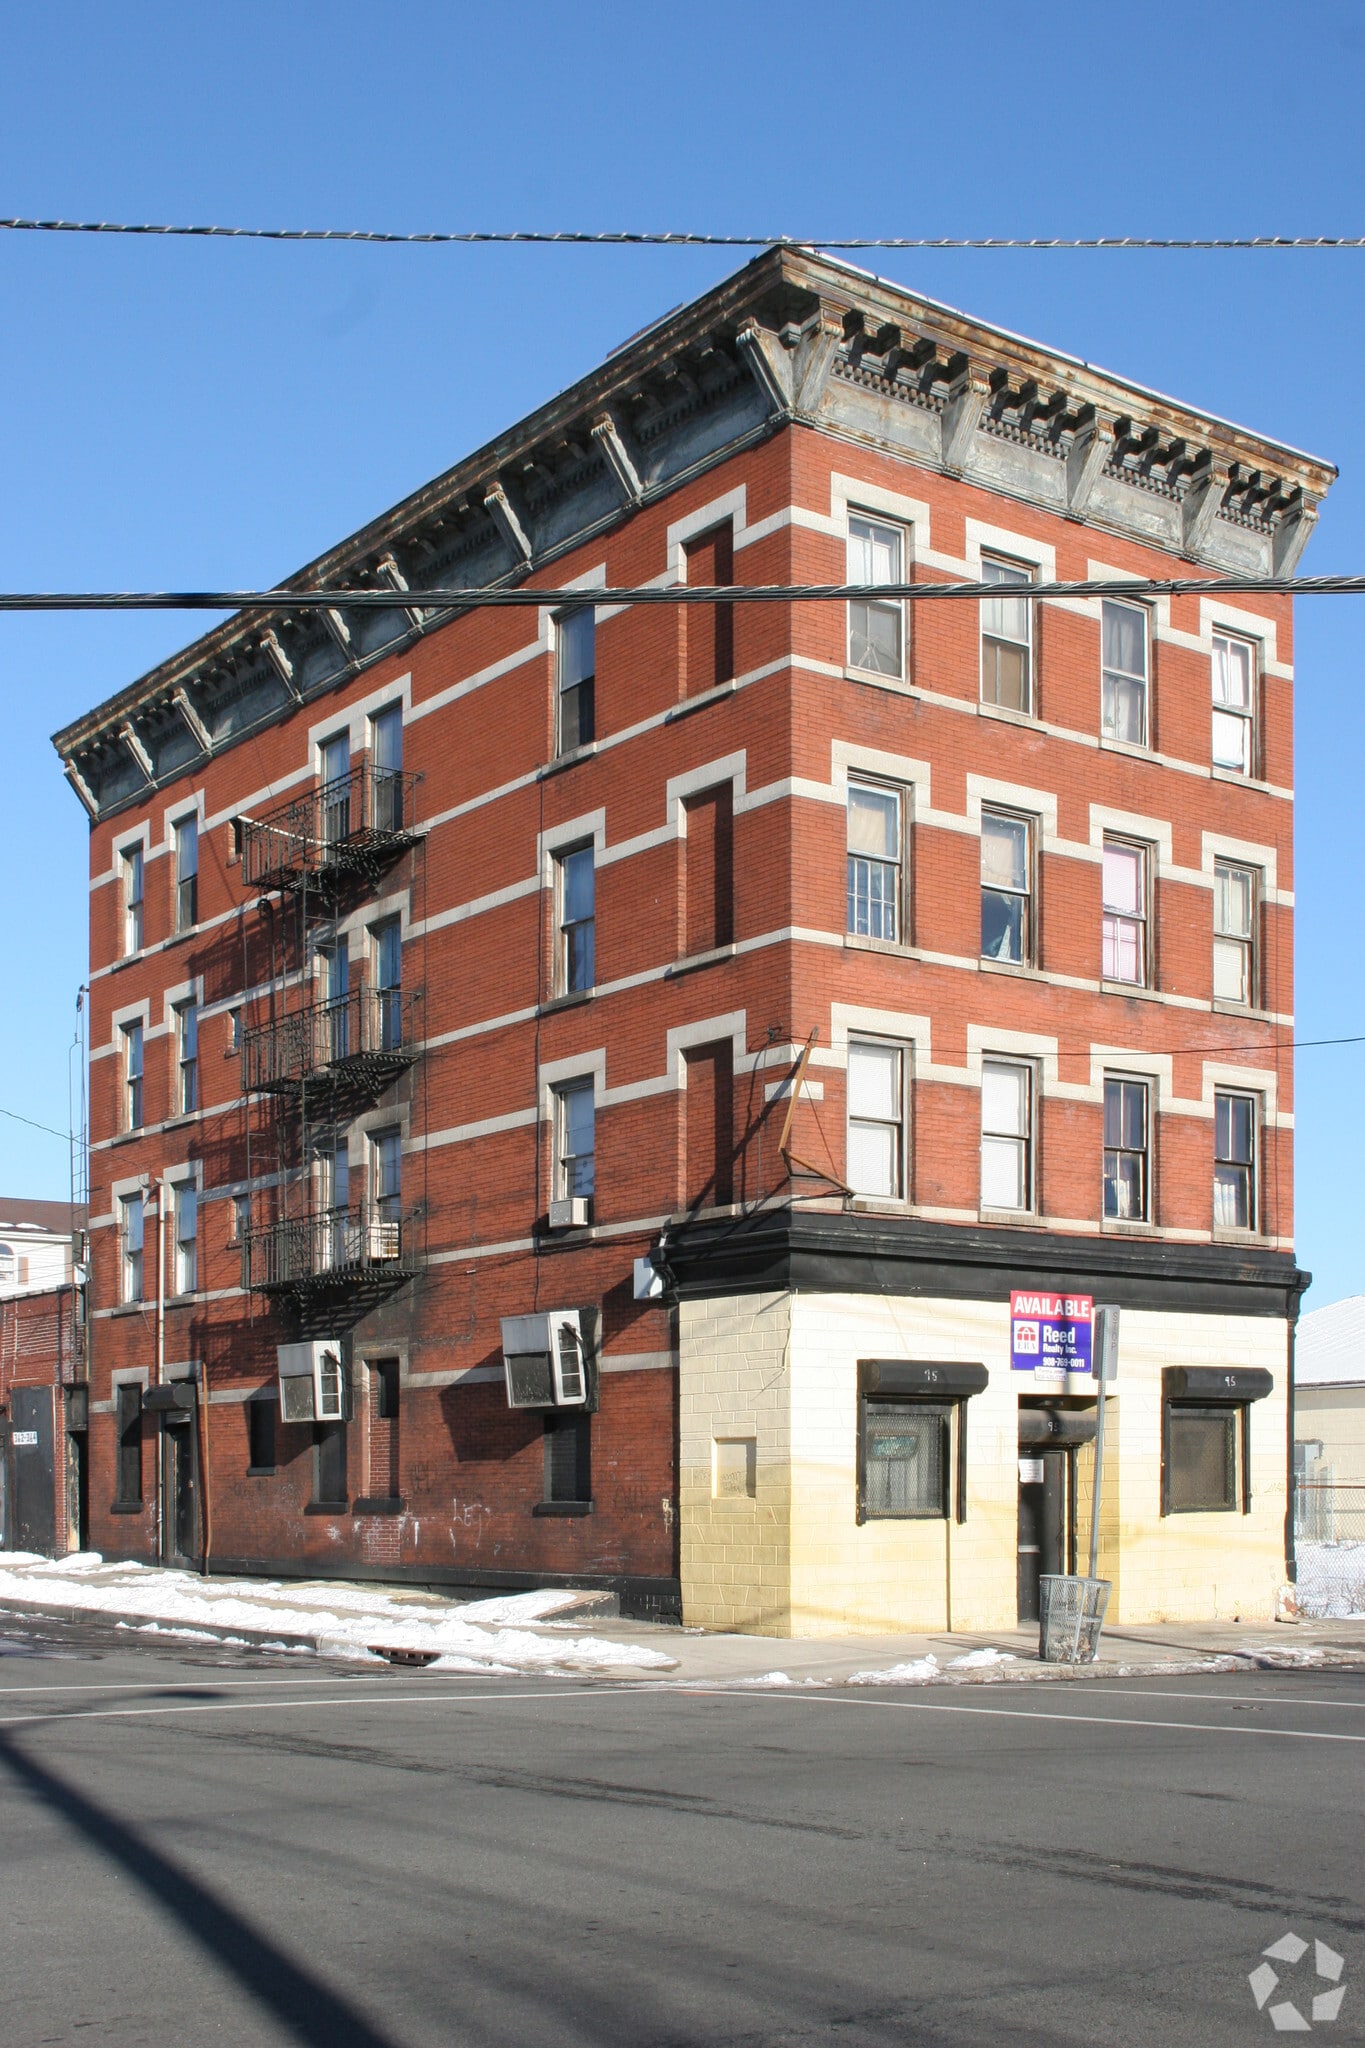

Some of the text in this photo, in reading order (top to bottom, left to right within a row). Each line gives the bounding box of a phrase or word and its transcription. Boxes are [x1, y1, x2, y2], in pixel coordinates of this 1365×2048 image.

[1014, 1296, 1089, 1317] AVAILABLE
[1043, 1326, 1075, 1343] Reed
[1111, 1311, 1119, 1350] STOP
[1017, 1341, 1036, 1350] ERA
[1043, 1343, 1077, 1355] Realty Inc.
[1225, 1376, 1236, 1387] 95
